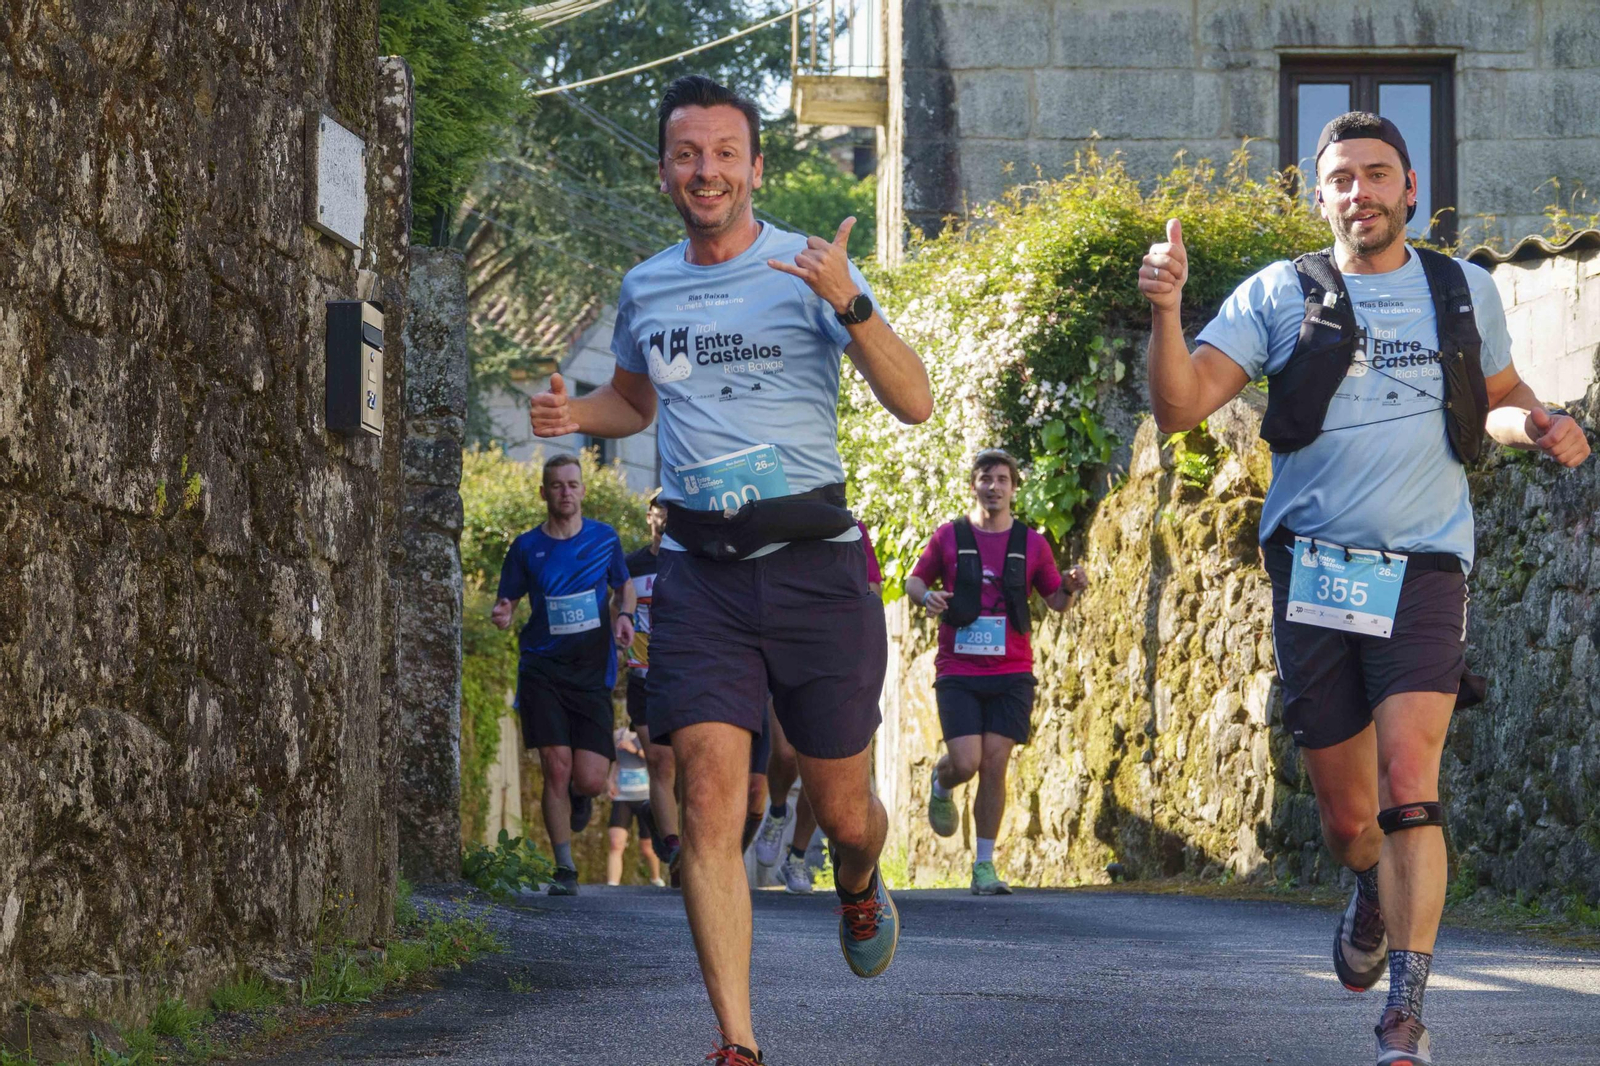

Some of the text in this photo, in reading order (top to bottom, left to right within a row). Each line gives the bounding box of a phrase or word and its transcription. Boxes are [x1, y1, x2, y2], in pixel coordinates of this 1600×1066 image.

[1378, 300, 1404, 308] Baixas
[1391, 307, 1422, 315] destino
[695, 320, 718, 334] Trail
[1310, 316, 1342, 330] SALOMON
[1373, 327, 1397, 339] Trail
[695, 332, 743, 351] Entre
[1373, 339, 1422, 355] Entre
[696, 343, 782, 366] Castelos
[724, 363, 746, 374] Rías
[747, 360, 784, 372] Baixas
[1395, 369, 1418, 379] Rías
[754, 460, 768, 471] 26
[1378, 567, 1391, 577] 26
[1316, 575, 1369, 607] 355
[561, 608, 585, 623] 138
[967, 631, 992, 644] 289
